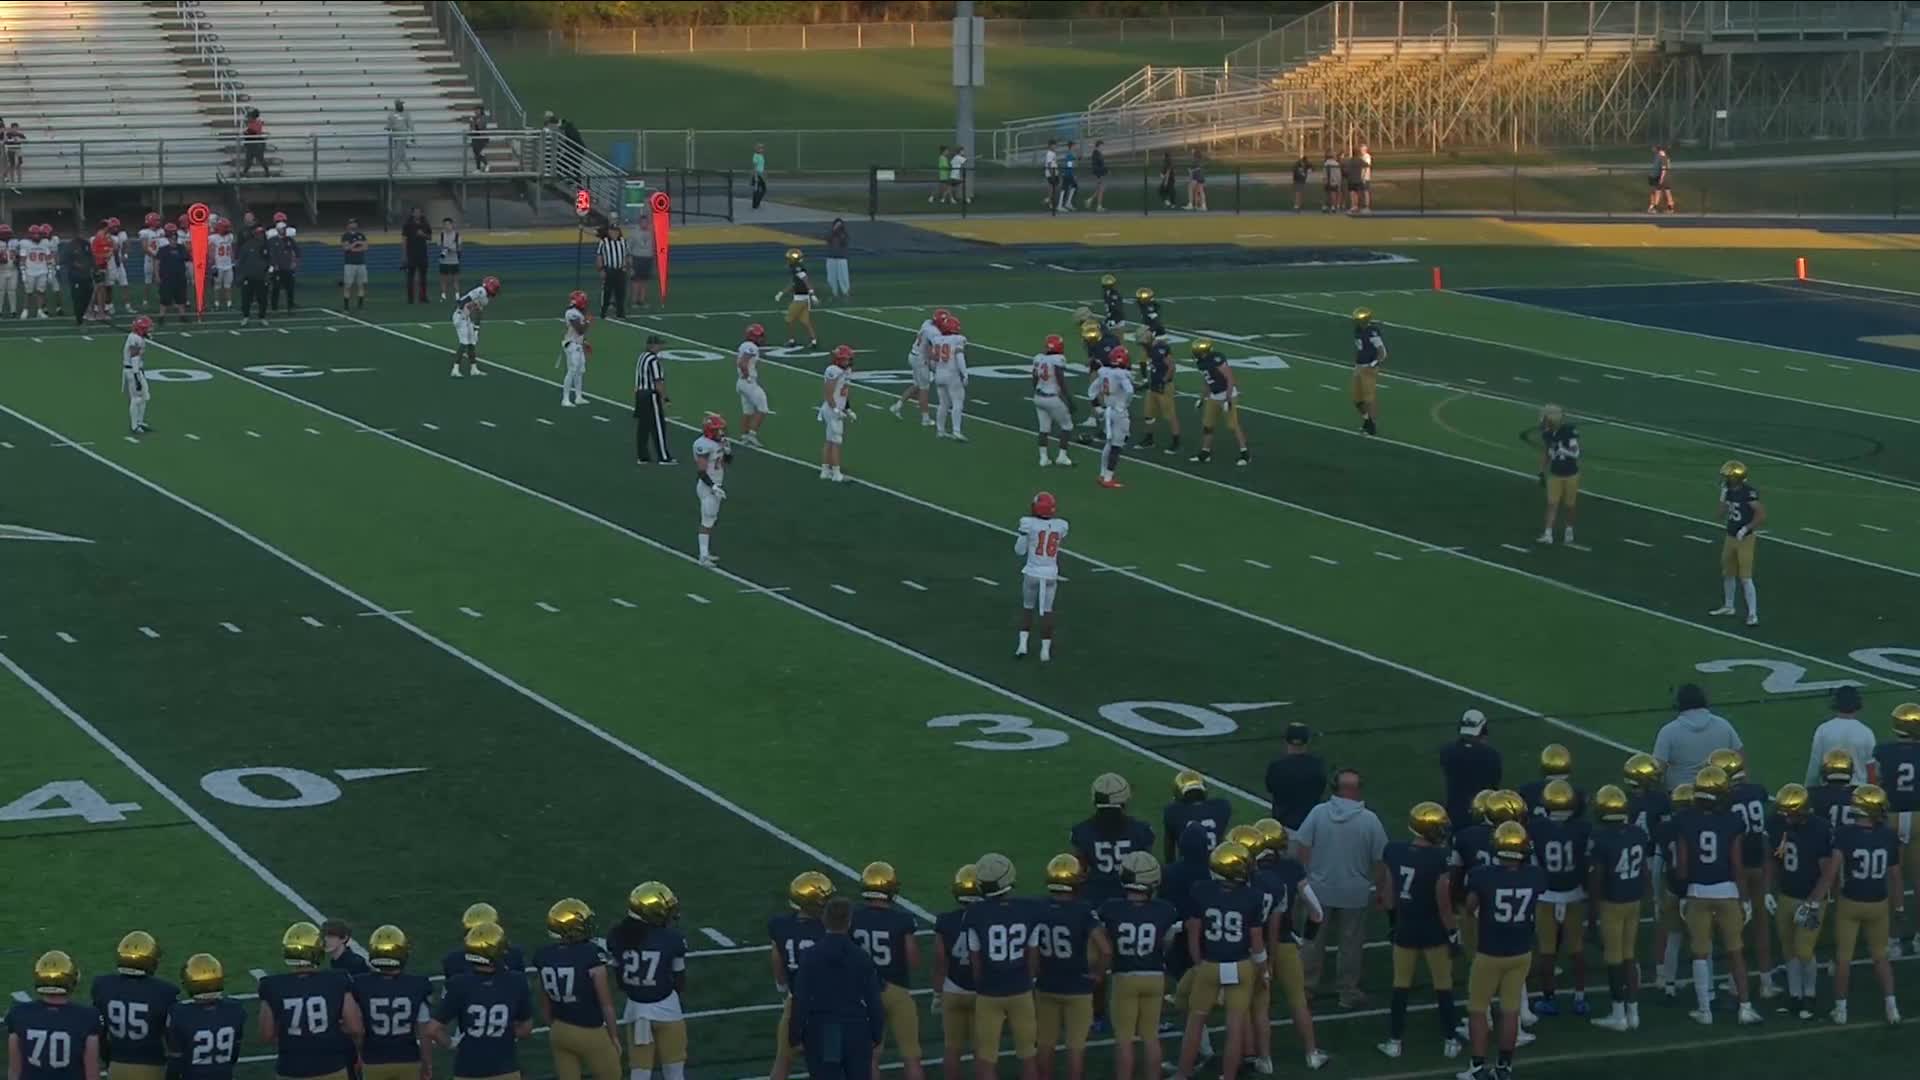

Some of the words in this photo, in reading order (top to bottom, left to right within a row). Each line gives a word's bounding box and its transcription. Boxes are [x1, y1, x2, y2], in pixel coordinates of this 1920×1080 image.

[1615, 844, 1643, 880] 42
[1699, 830, 1717, 863] 9
[1852, 848, 1888, 879] 30
[1400, 866, 1415, 899] 7
[1494, 887, 1534, 922] 57
[988, 923, 1027, 960] 82
[1117, 923, 1156, 956] 28
[1205, 908, 1242, 942] 39
[622, 950, 660, 986] 27
[107, 1000, 149, 1041] 95
[283, 996, 328, 1036] 78
[369, 996, 412, 1036] 52
[26, 1030, 70, 1068] 70
[193, 1026, 235, 1064] 29
